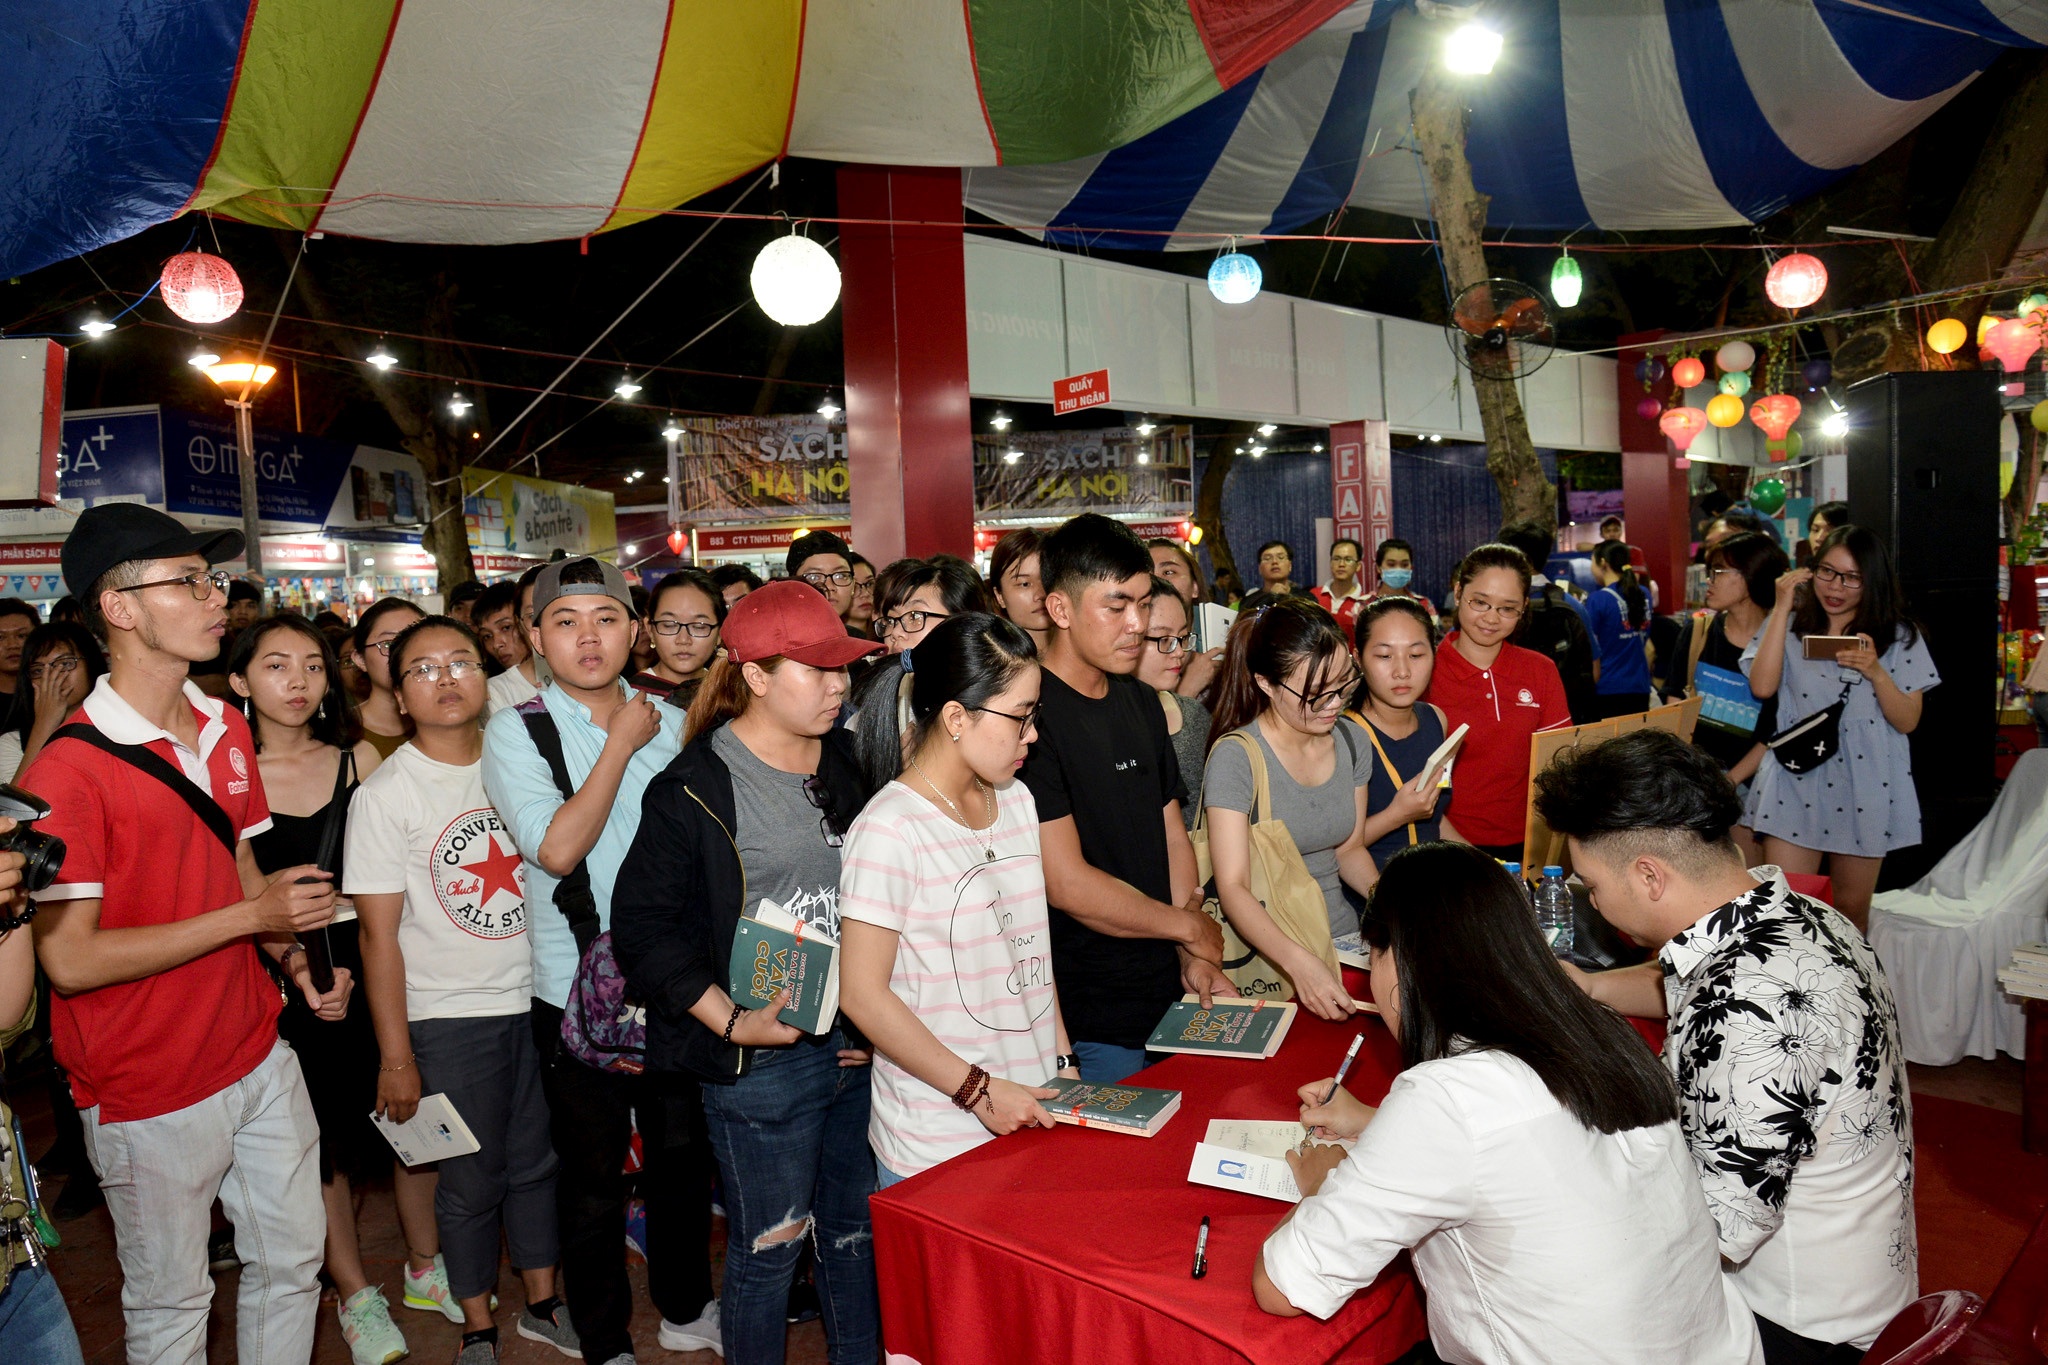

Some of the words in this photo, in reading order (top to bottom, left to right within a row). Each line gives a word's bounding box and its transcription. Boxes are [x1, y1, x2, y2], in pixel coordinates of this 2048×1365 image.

[1059, 399, 1079, 411] THU
[1080, 391, 1106, 406] NGÂN
[715, 417, 740, 431] CÔNG
[741, 419, 753, 429] TY
[759, 427, 848, 463] SÁCH
[751, 463, 797, 497] HÀ
[803, 461, 850, 500] NỘ
[1080, 470, 1129, 502] NỘI
[533, 490, 562, 516] Sách
[25, 547, 46, 559] SÁCH
[709, 537, 725, 546] B83
[732, 535, 748, 545] CTY
[749, 534, 772, 544] TNHH
[443, 817, 507, 866] CONVE
[446, 878, 480, 897] Chuck
[457, 902, 495, 929] ALL
[501, 901, 526, 928] ST
[1006, 956, 1053, 995] GIRL
